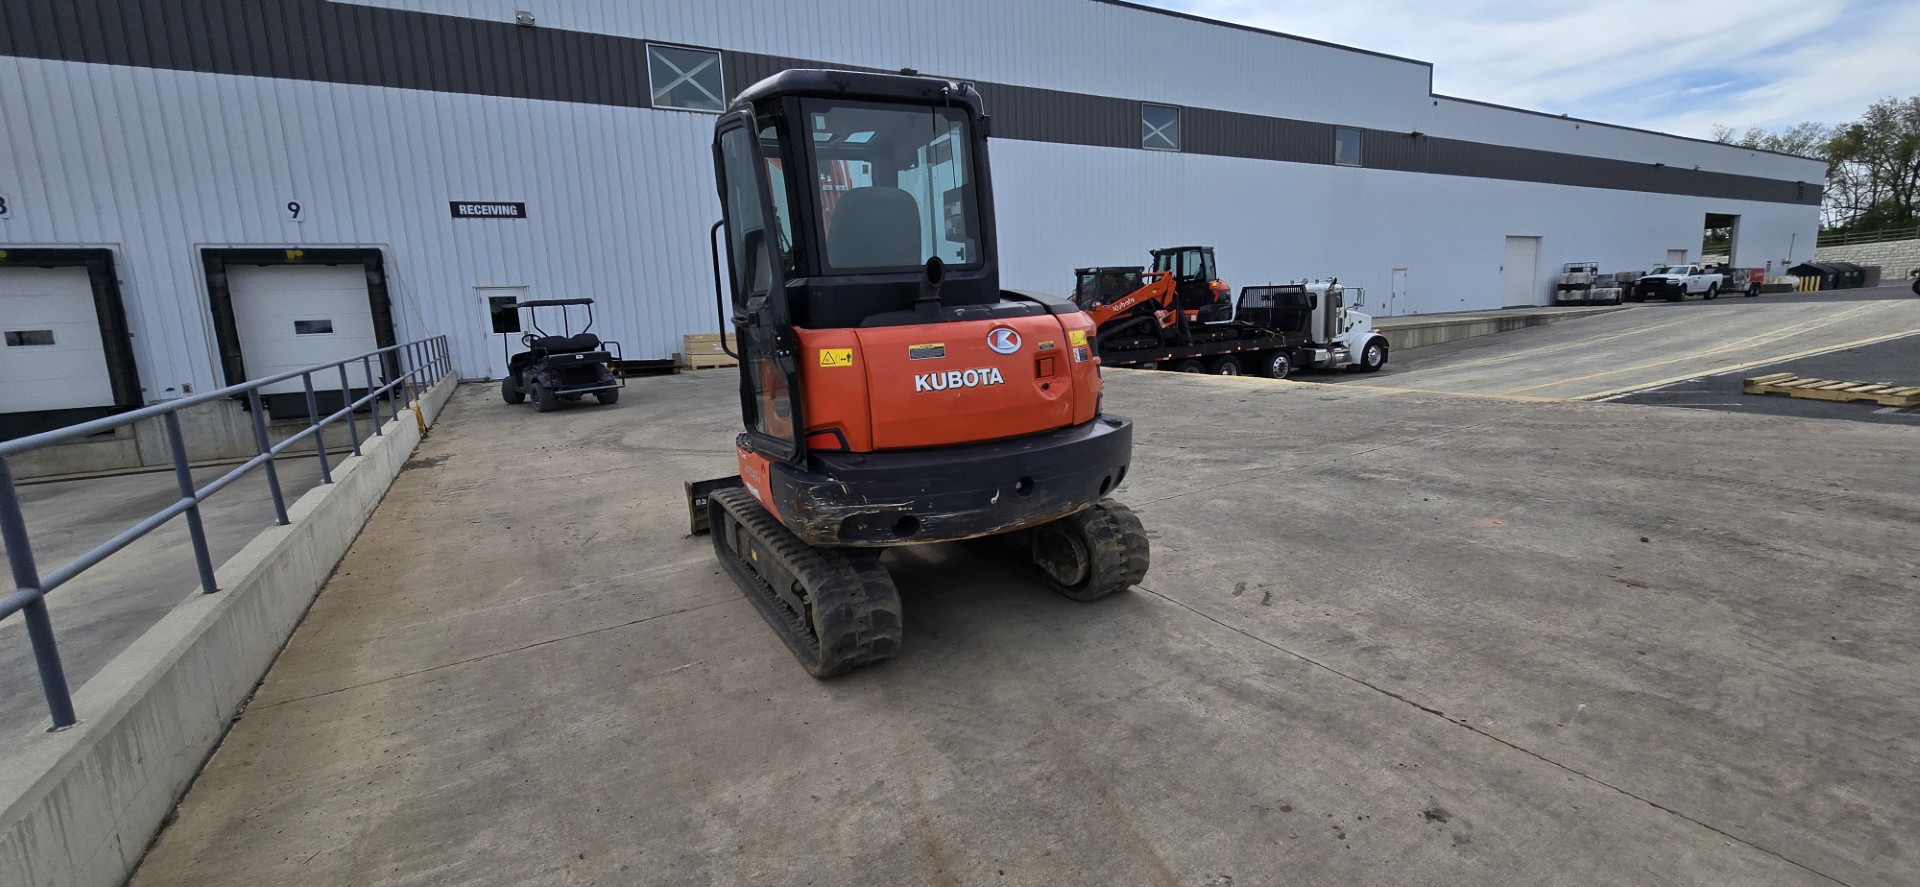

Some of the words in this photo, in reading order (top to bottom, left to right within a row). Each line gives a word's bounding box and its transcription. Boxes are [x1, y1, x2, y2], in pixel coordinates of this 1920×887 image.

[288, 201, 300, 219] 9
[459, 204, 518, 216] RECEIVING
[1112, 297, 1135, 312] Kubota
[914, 367, 1004, 393] KUBOTA
